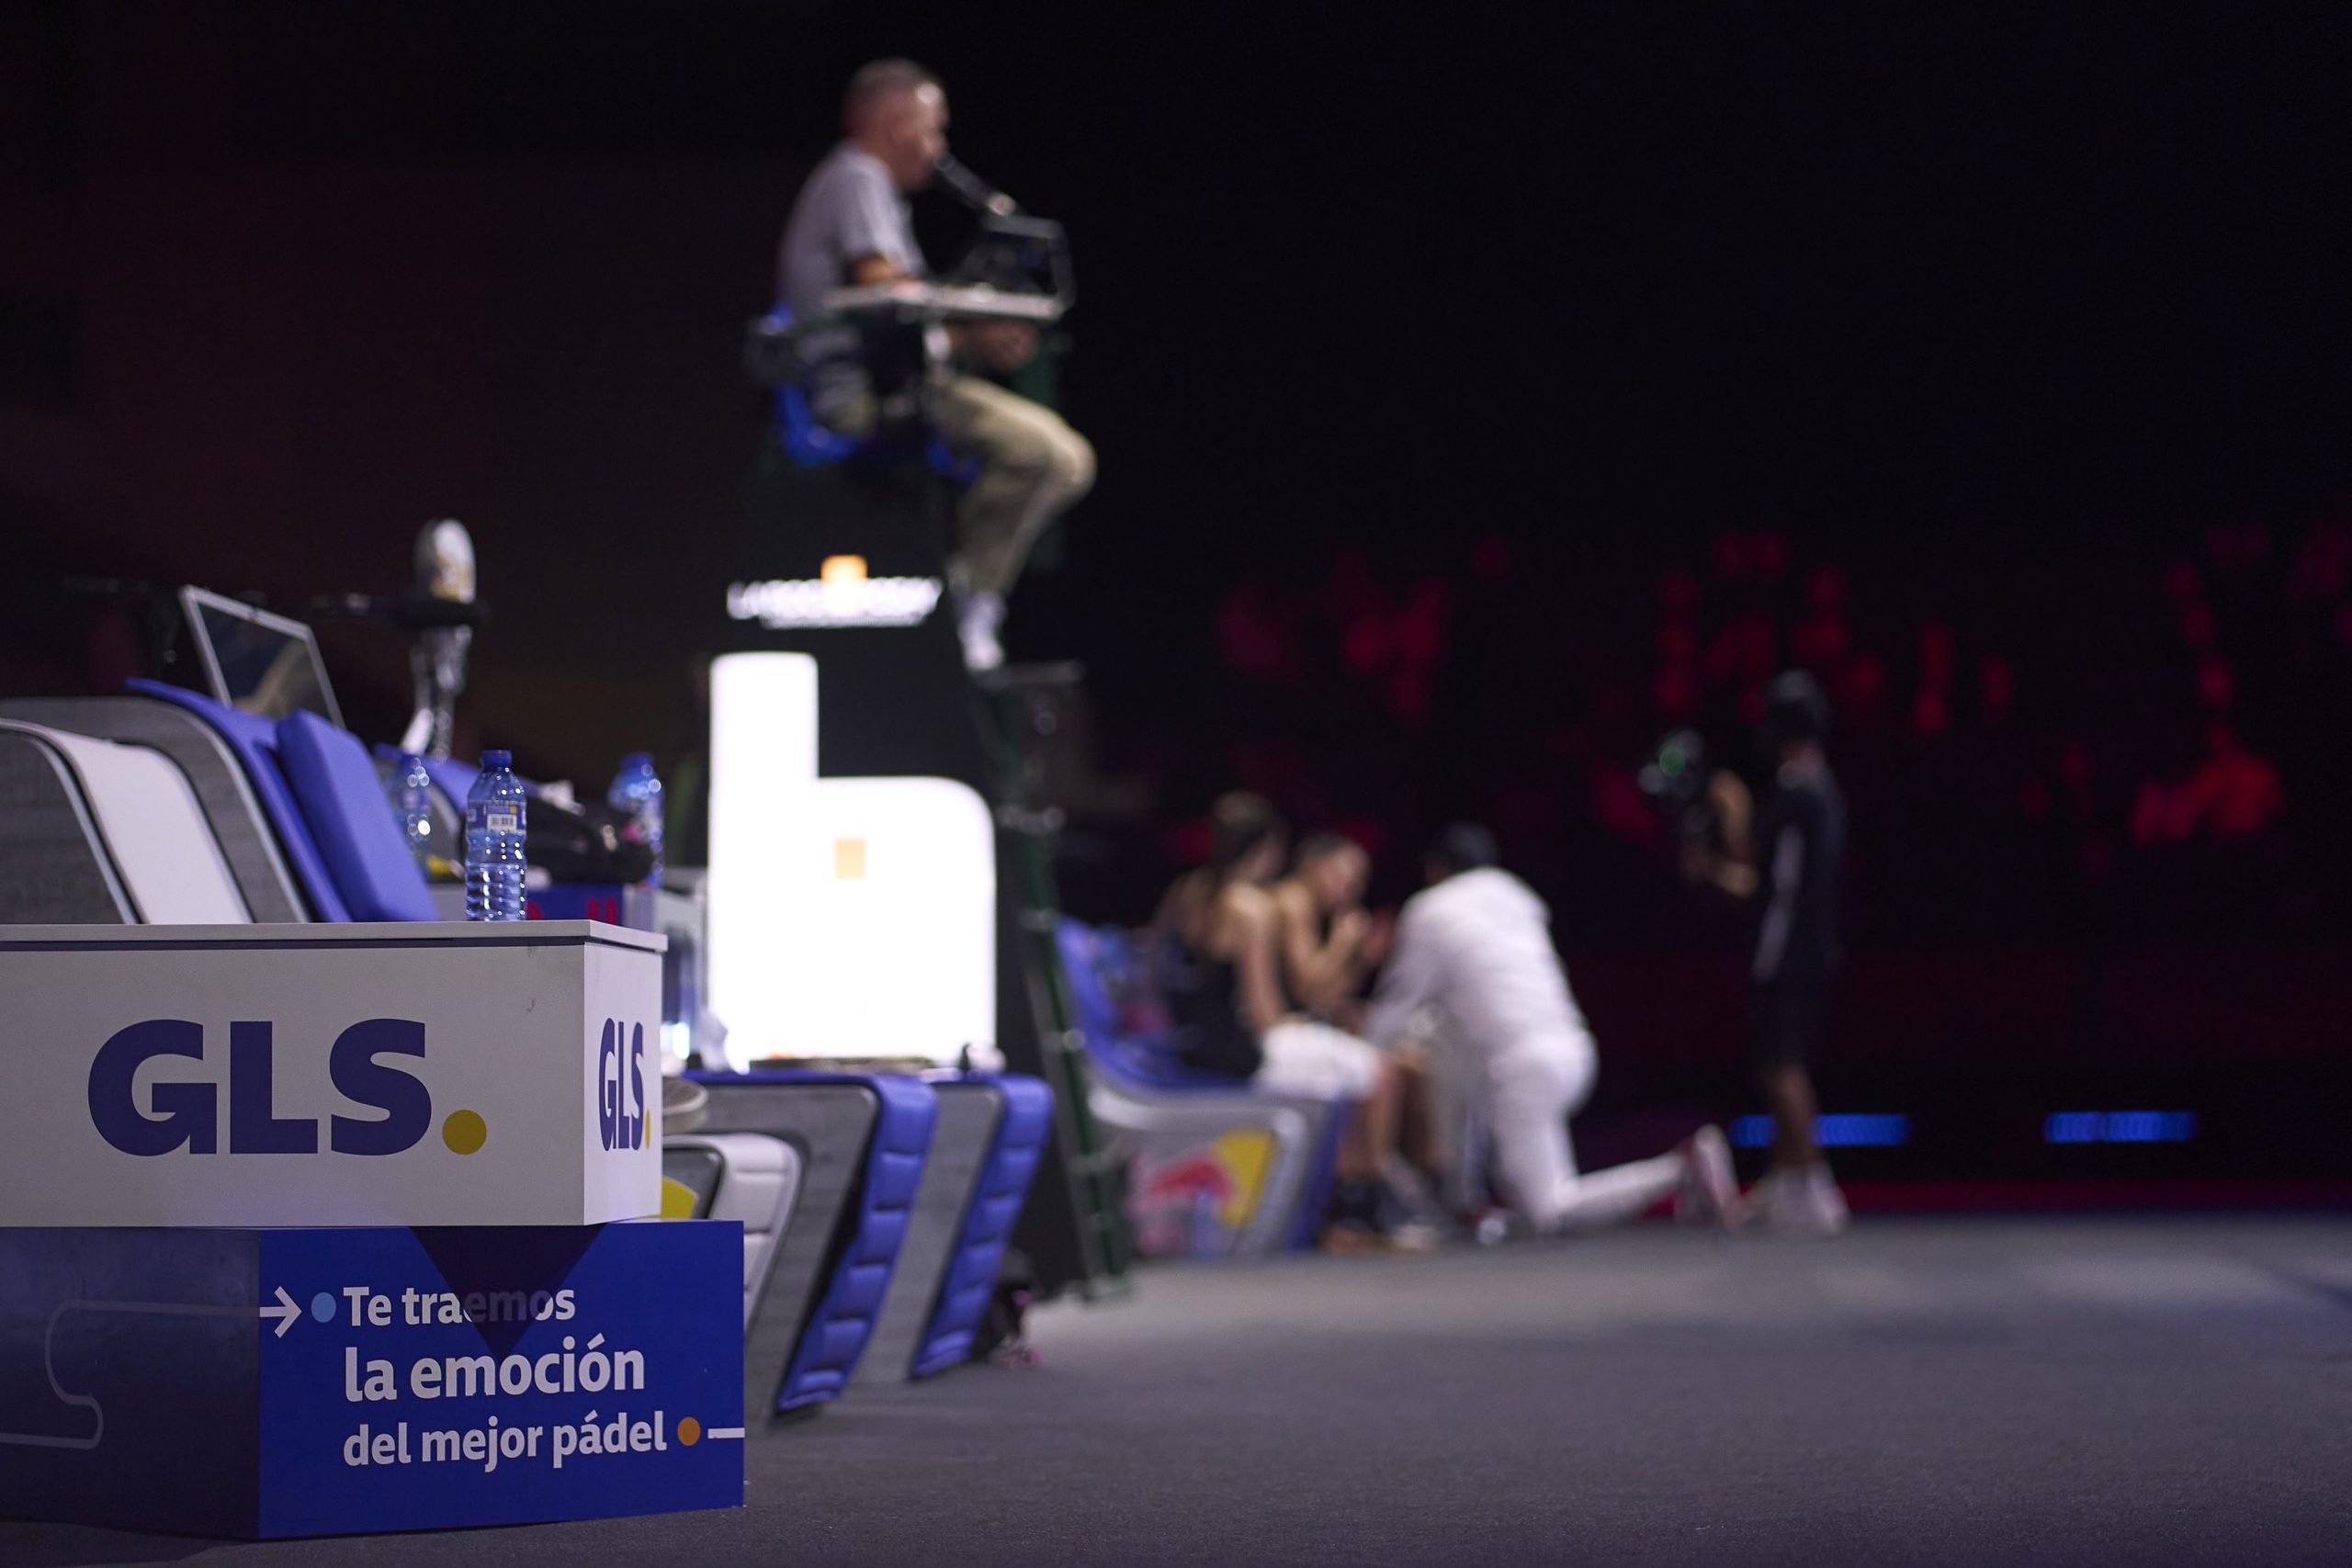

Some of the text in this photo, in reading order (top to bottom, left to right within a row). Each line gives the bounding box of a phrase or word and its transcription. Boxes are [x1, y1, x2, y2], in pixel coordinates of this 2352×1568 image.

[343, 1286, 577, 1326] Te traemos
[345, 1333, 645, 1403] la emoción
[343, 1410, 668, 1473] del mejor pádel
